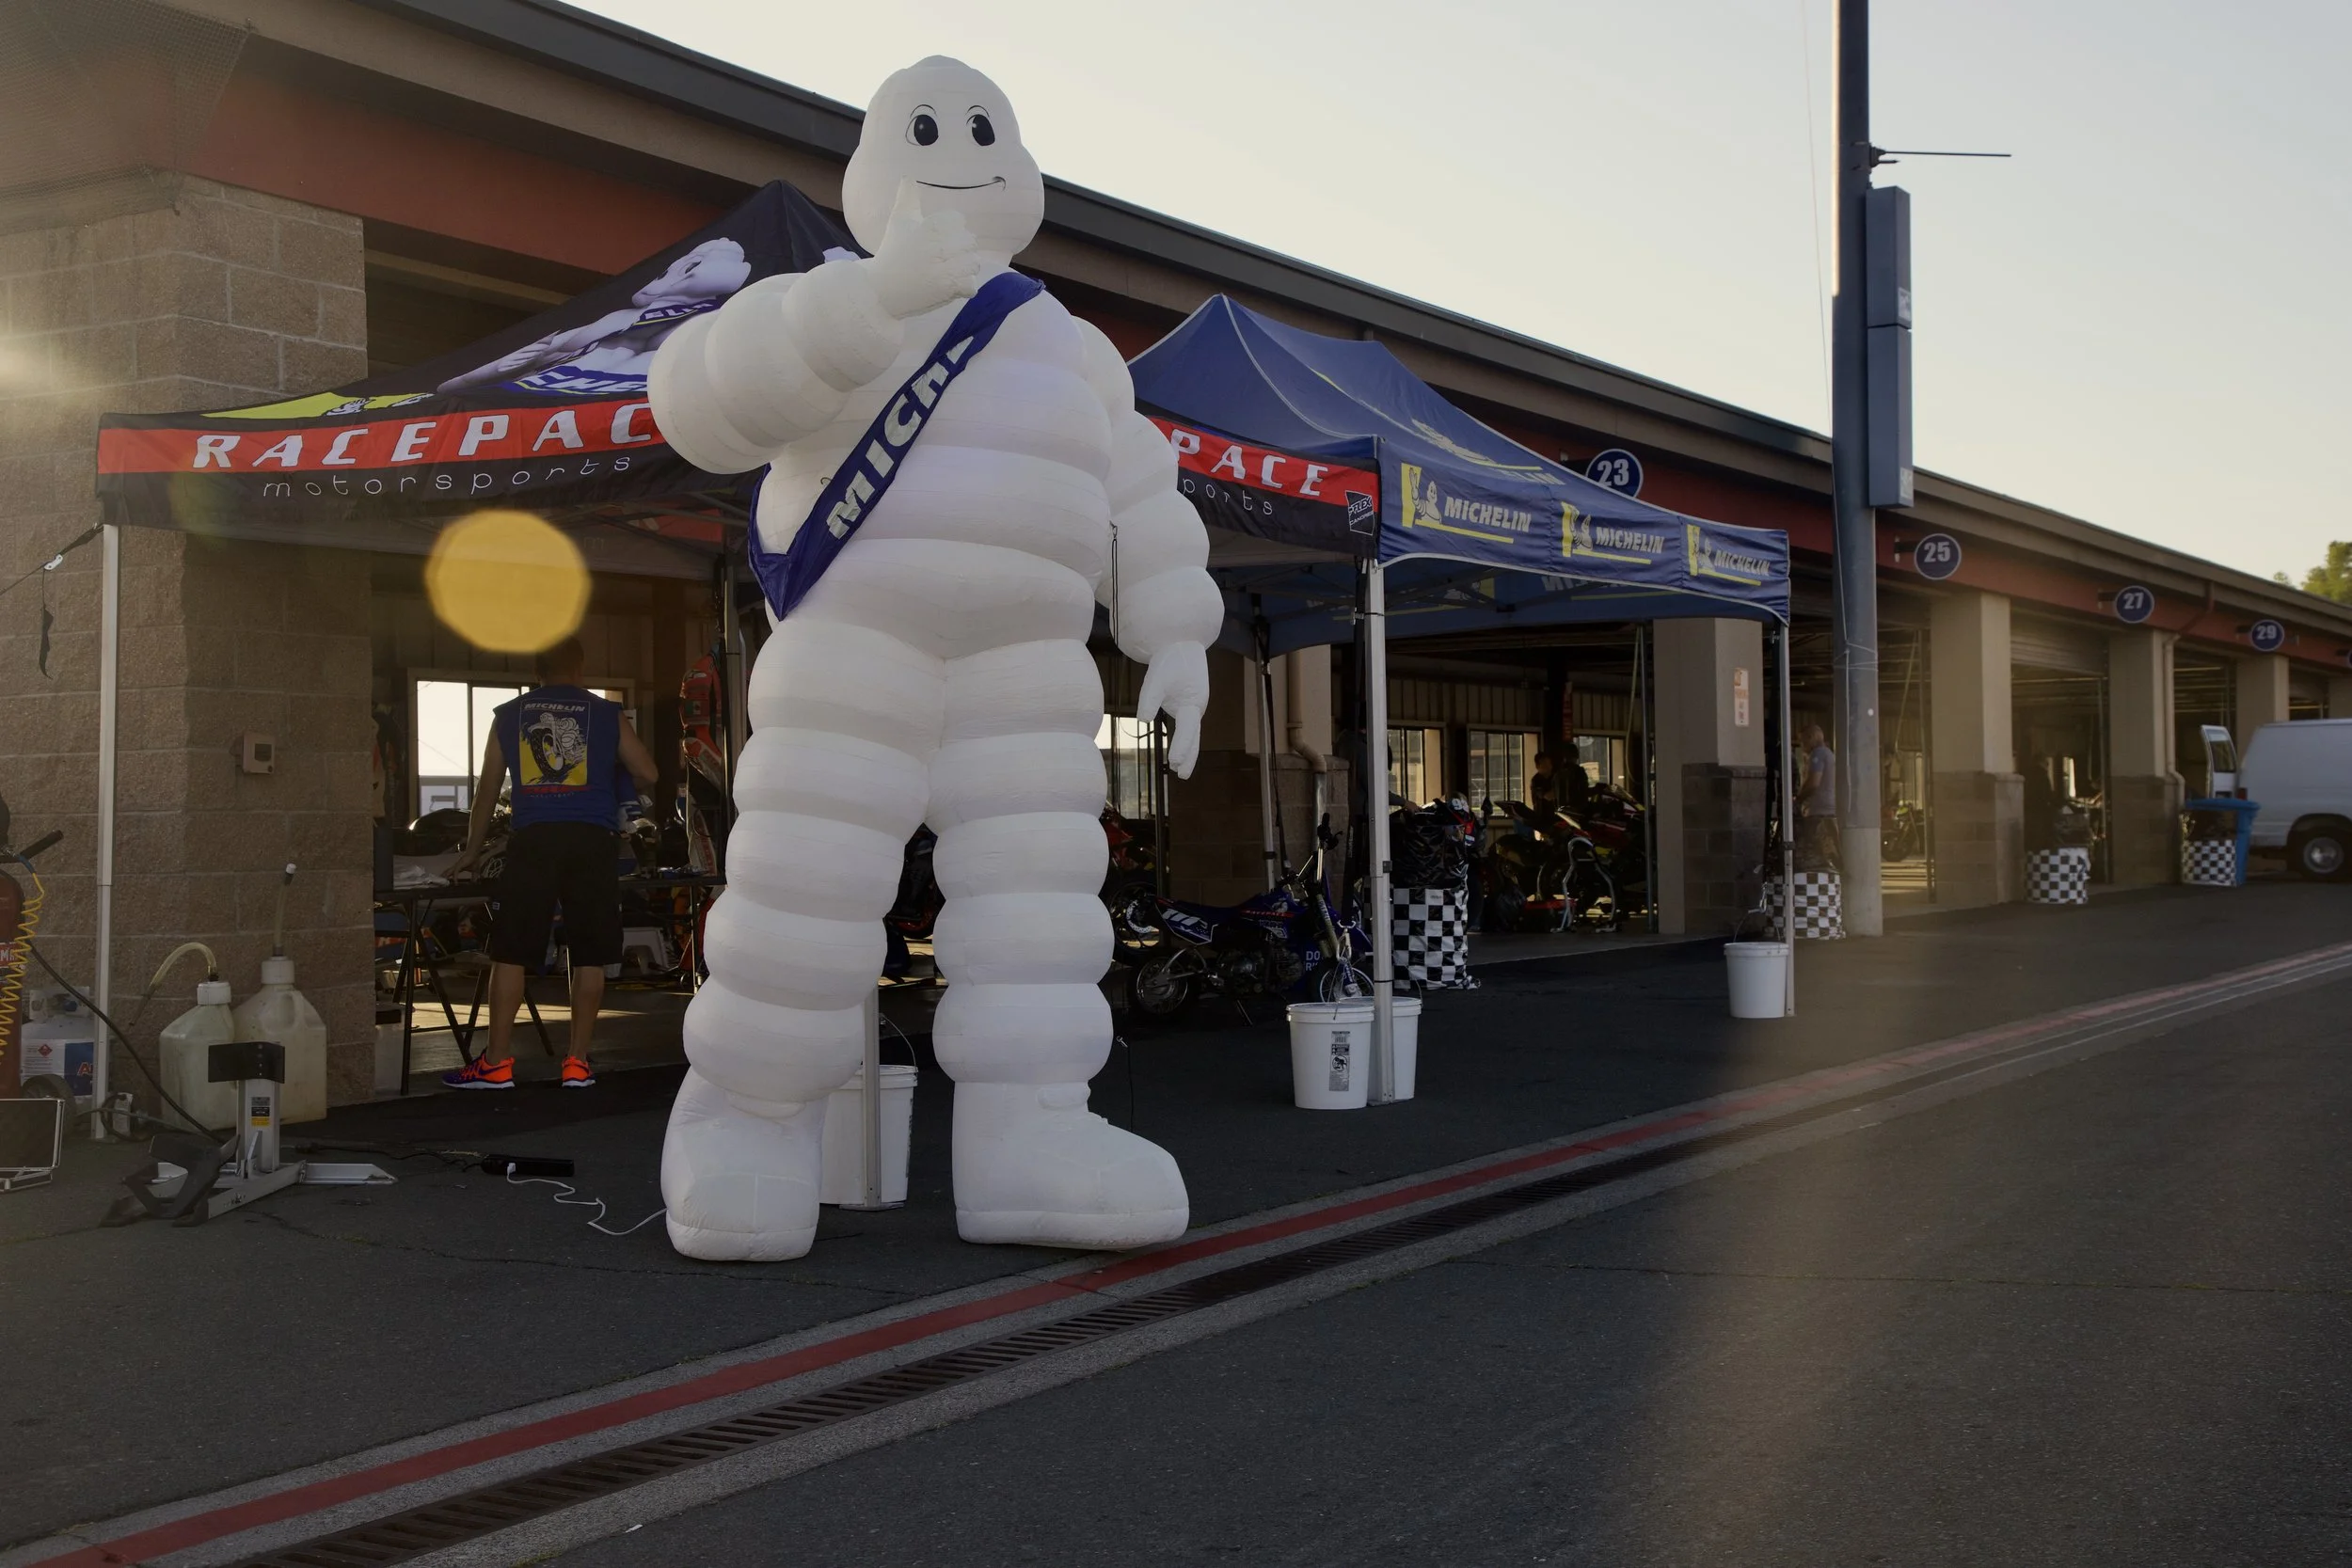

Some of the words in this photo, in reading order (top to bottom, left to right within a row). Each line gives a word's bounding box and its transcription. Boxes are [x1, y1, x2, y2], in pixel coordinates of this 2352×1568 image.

[263, 455, 631, 497] motorsports
[1597, 458, 1629, 486] 23
[1444, 496, 1532, 533] MICHELIN
[1596, 526, 1664, 554] MICHELIN
[1924, 542, 1951, 562] 25
[1715, 549, 1770, 577] MICHELIN
[2122, 593, 2144, 610] 27
[2257, 625, 2277, 641] 29
[523, 703, 585, 712] MICHELIN
